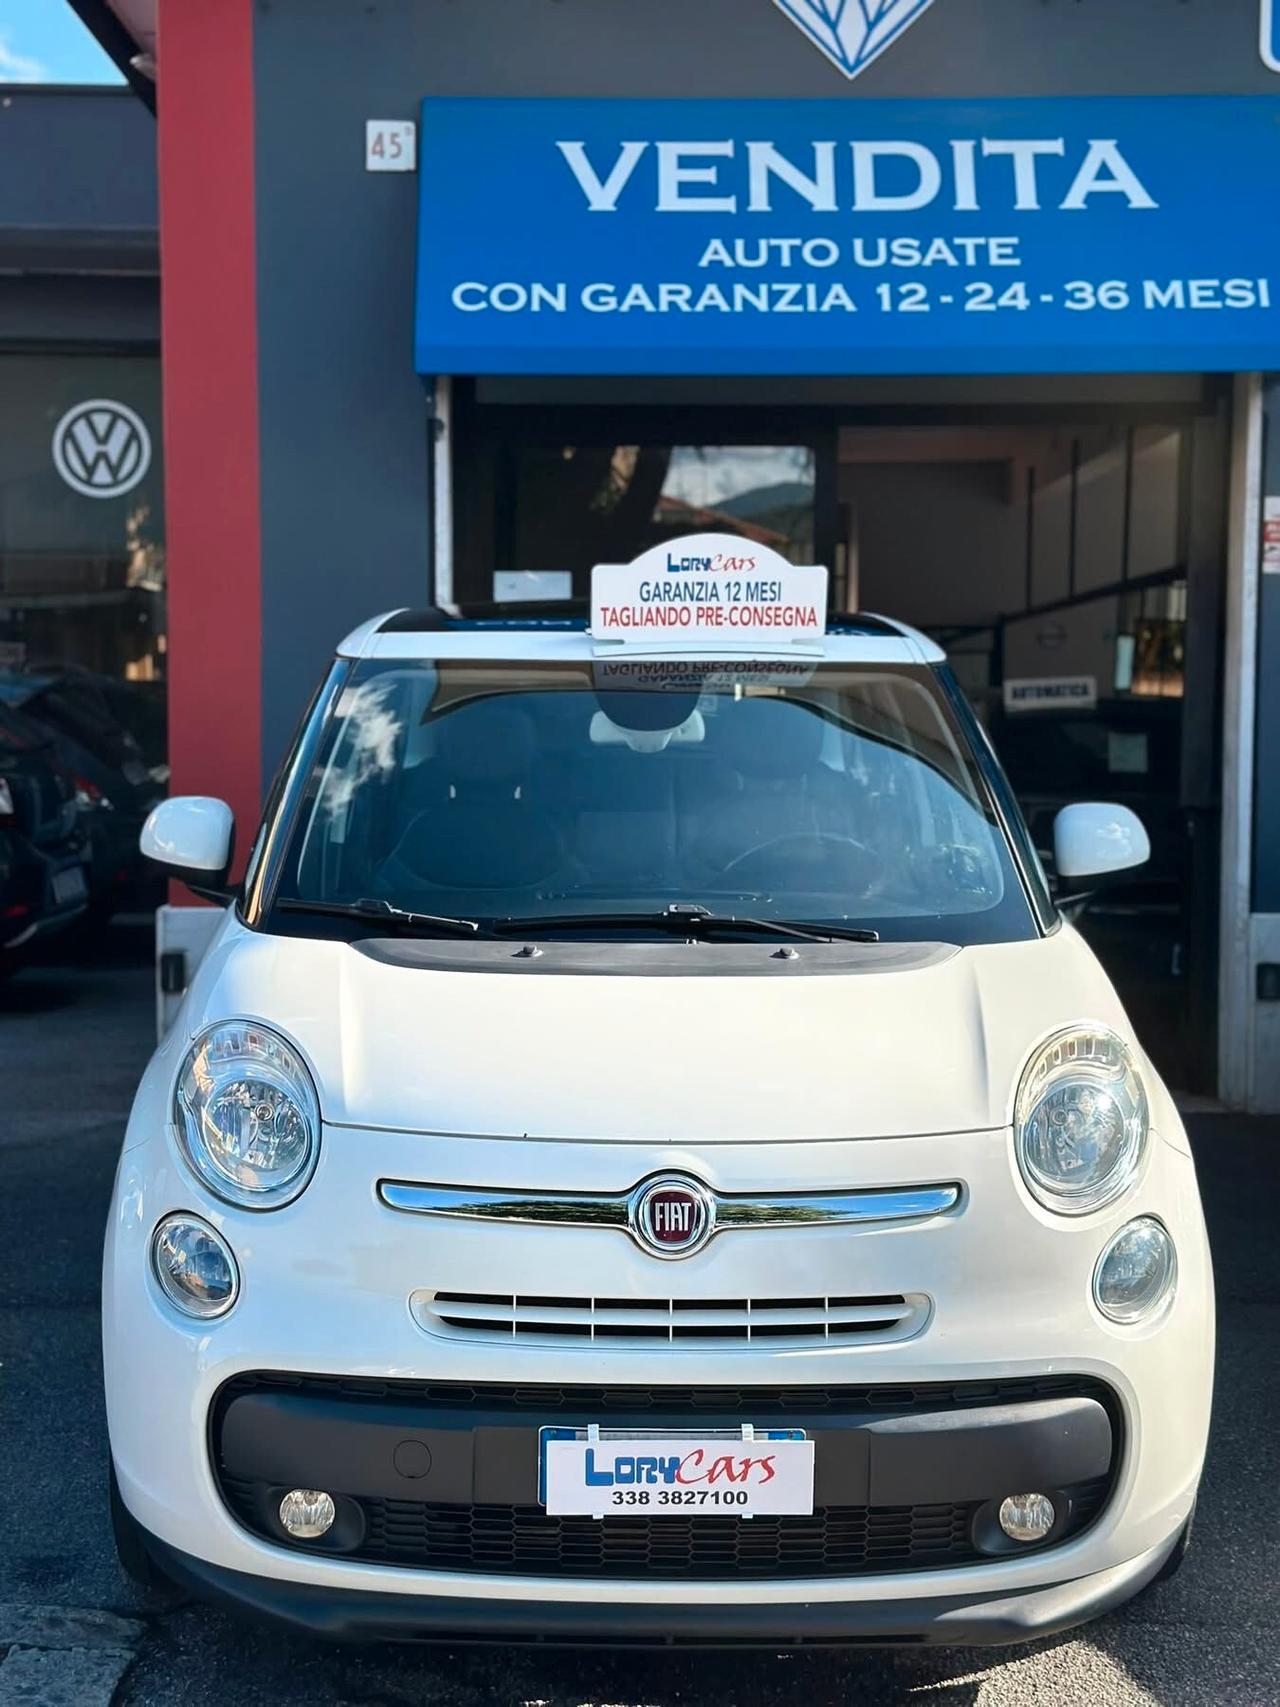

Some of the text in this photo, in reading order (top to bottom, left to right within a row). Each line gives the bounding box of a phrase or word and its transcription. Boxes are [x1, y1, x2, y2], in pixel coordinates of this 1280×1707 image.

[555, 138, 1159, 214] VENDITA
[698, 236, 1021, 268] AUTO USATE
[452, 282, 567, 312] CON
[580, 283, 857, 313] GARANZIA
[876, 282, 930, 312] 12
[964, 281, 1030, 311] 24
[1064, 281, 1130, 310] 36
[1143, 279, 1270, 309] MESI
[639, 581, 781, 603] GARANZIA 12 MESI
[600, 606, 818, 628] TAGLIANDO PRE-CONSEGNA
[654, 1202, 692, 1231] FIAT
[612, 1490, 748, 1505] 338 3827100
